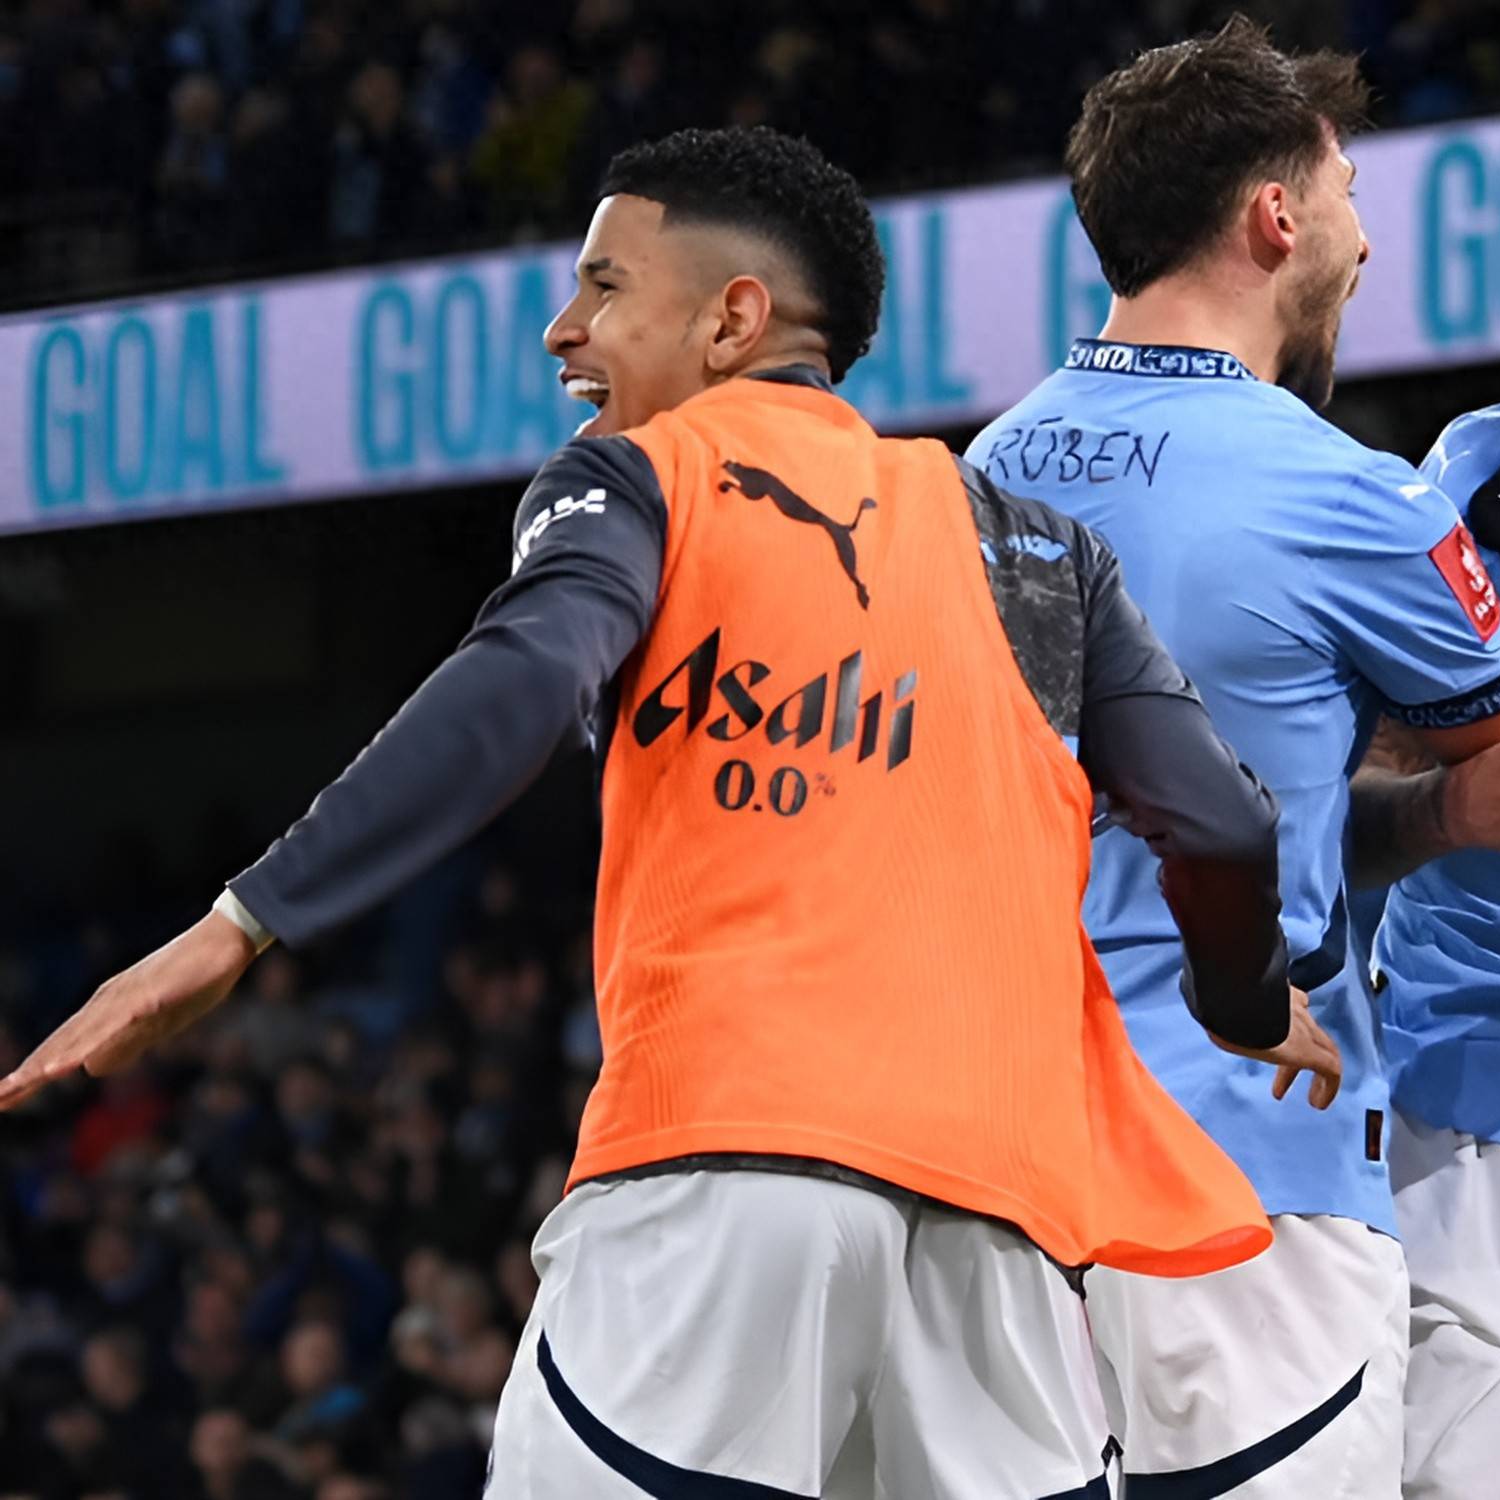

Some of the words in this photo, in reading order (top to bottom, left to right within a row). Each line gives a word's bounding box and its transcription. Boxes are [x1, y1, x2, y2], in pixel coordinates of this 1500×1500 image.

[31, 294, 284, 507] GOAL
[357, 264, 563, 473] GOA
[632, 626, 916, 773] Asahi
